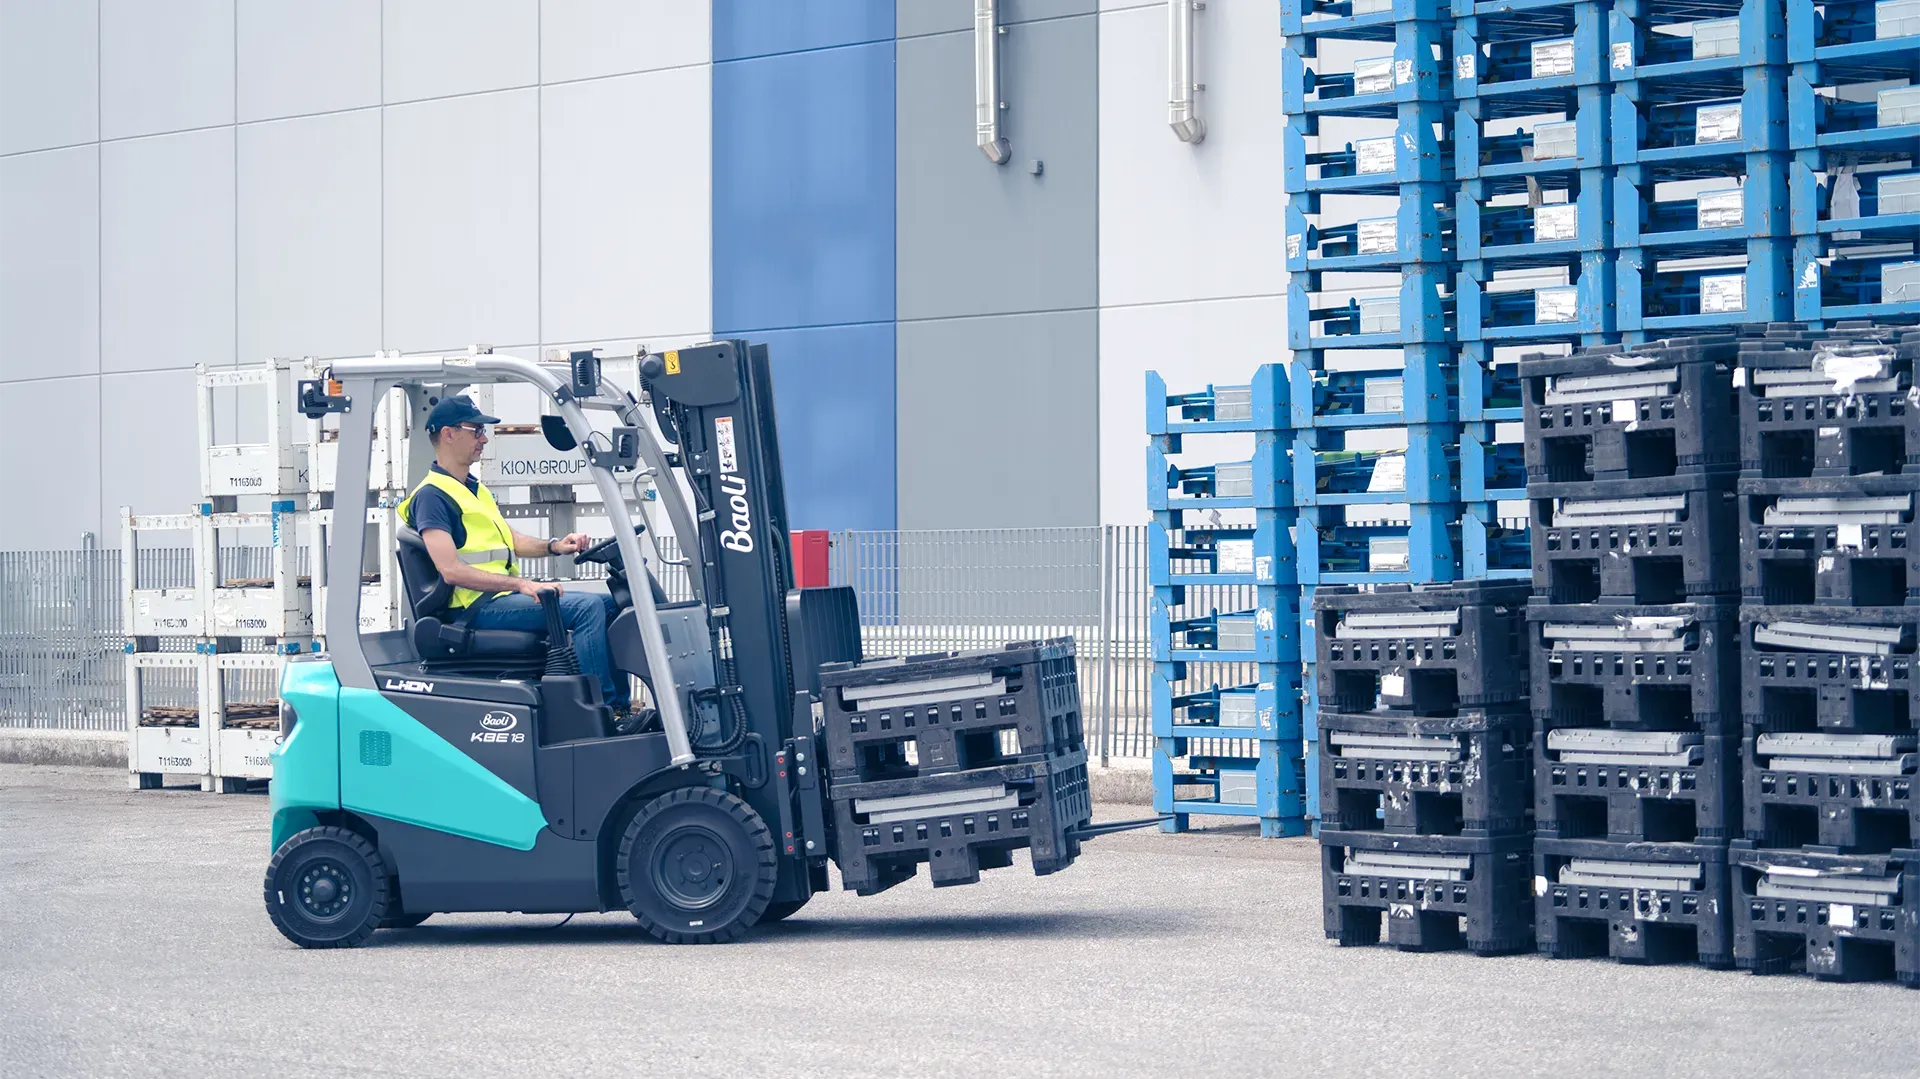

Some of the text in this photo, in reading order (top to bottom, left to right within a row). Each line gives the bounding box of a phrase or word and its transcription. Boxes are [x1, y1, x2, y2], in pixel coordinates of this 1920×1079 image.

[501, 459, 587, 475] KION GROUP
[229, 477, 262, 487] T1163000
[720, 474, 754, 553] Baoli
[482, 713, 510, 726] Baoli
[470, 732, 525, 743] KBE 18
[158, 756, 193, 767] T1163000
